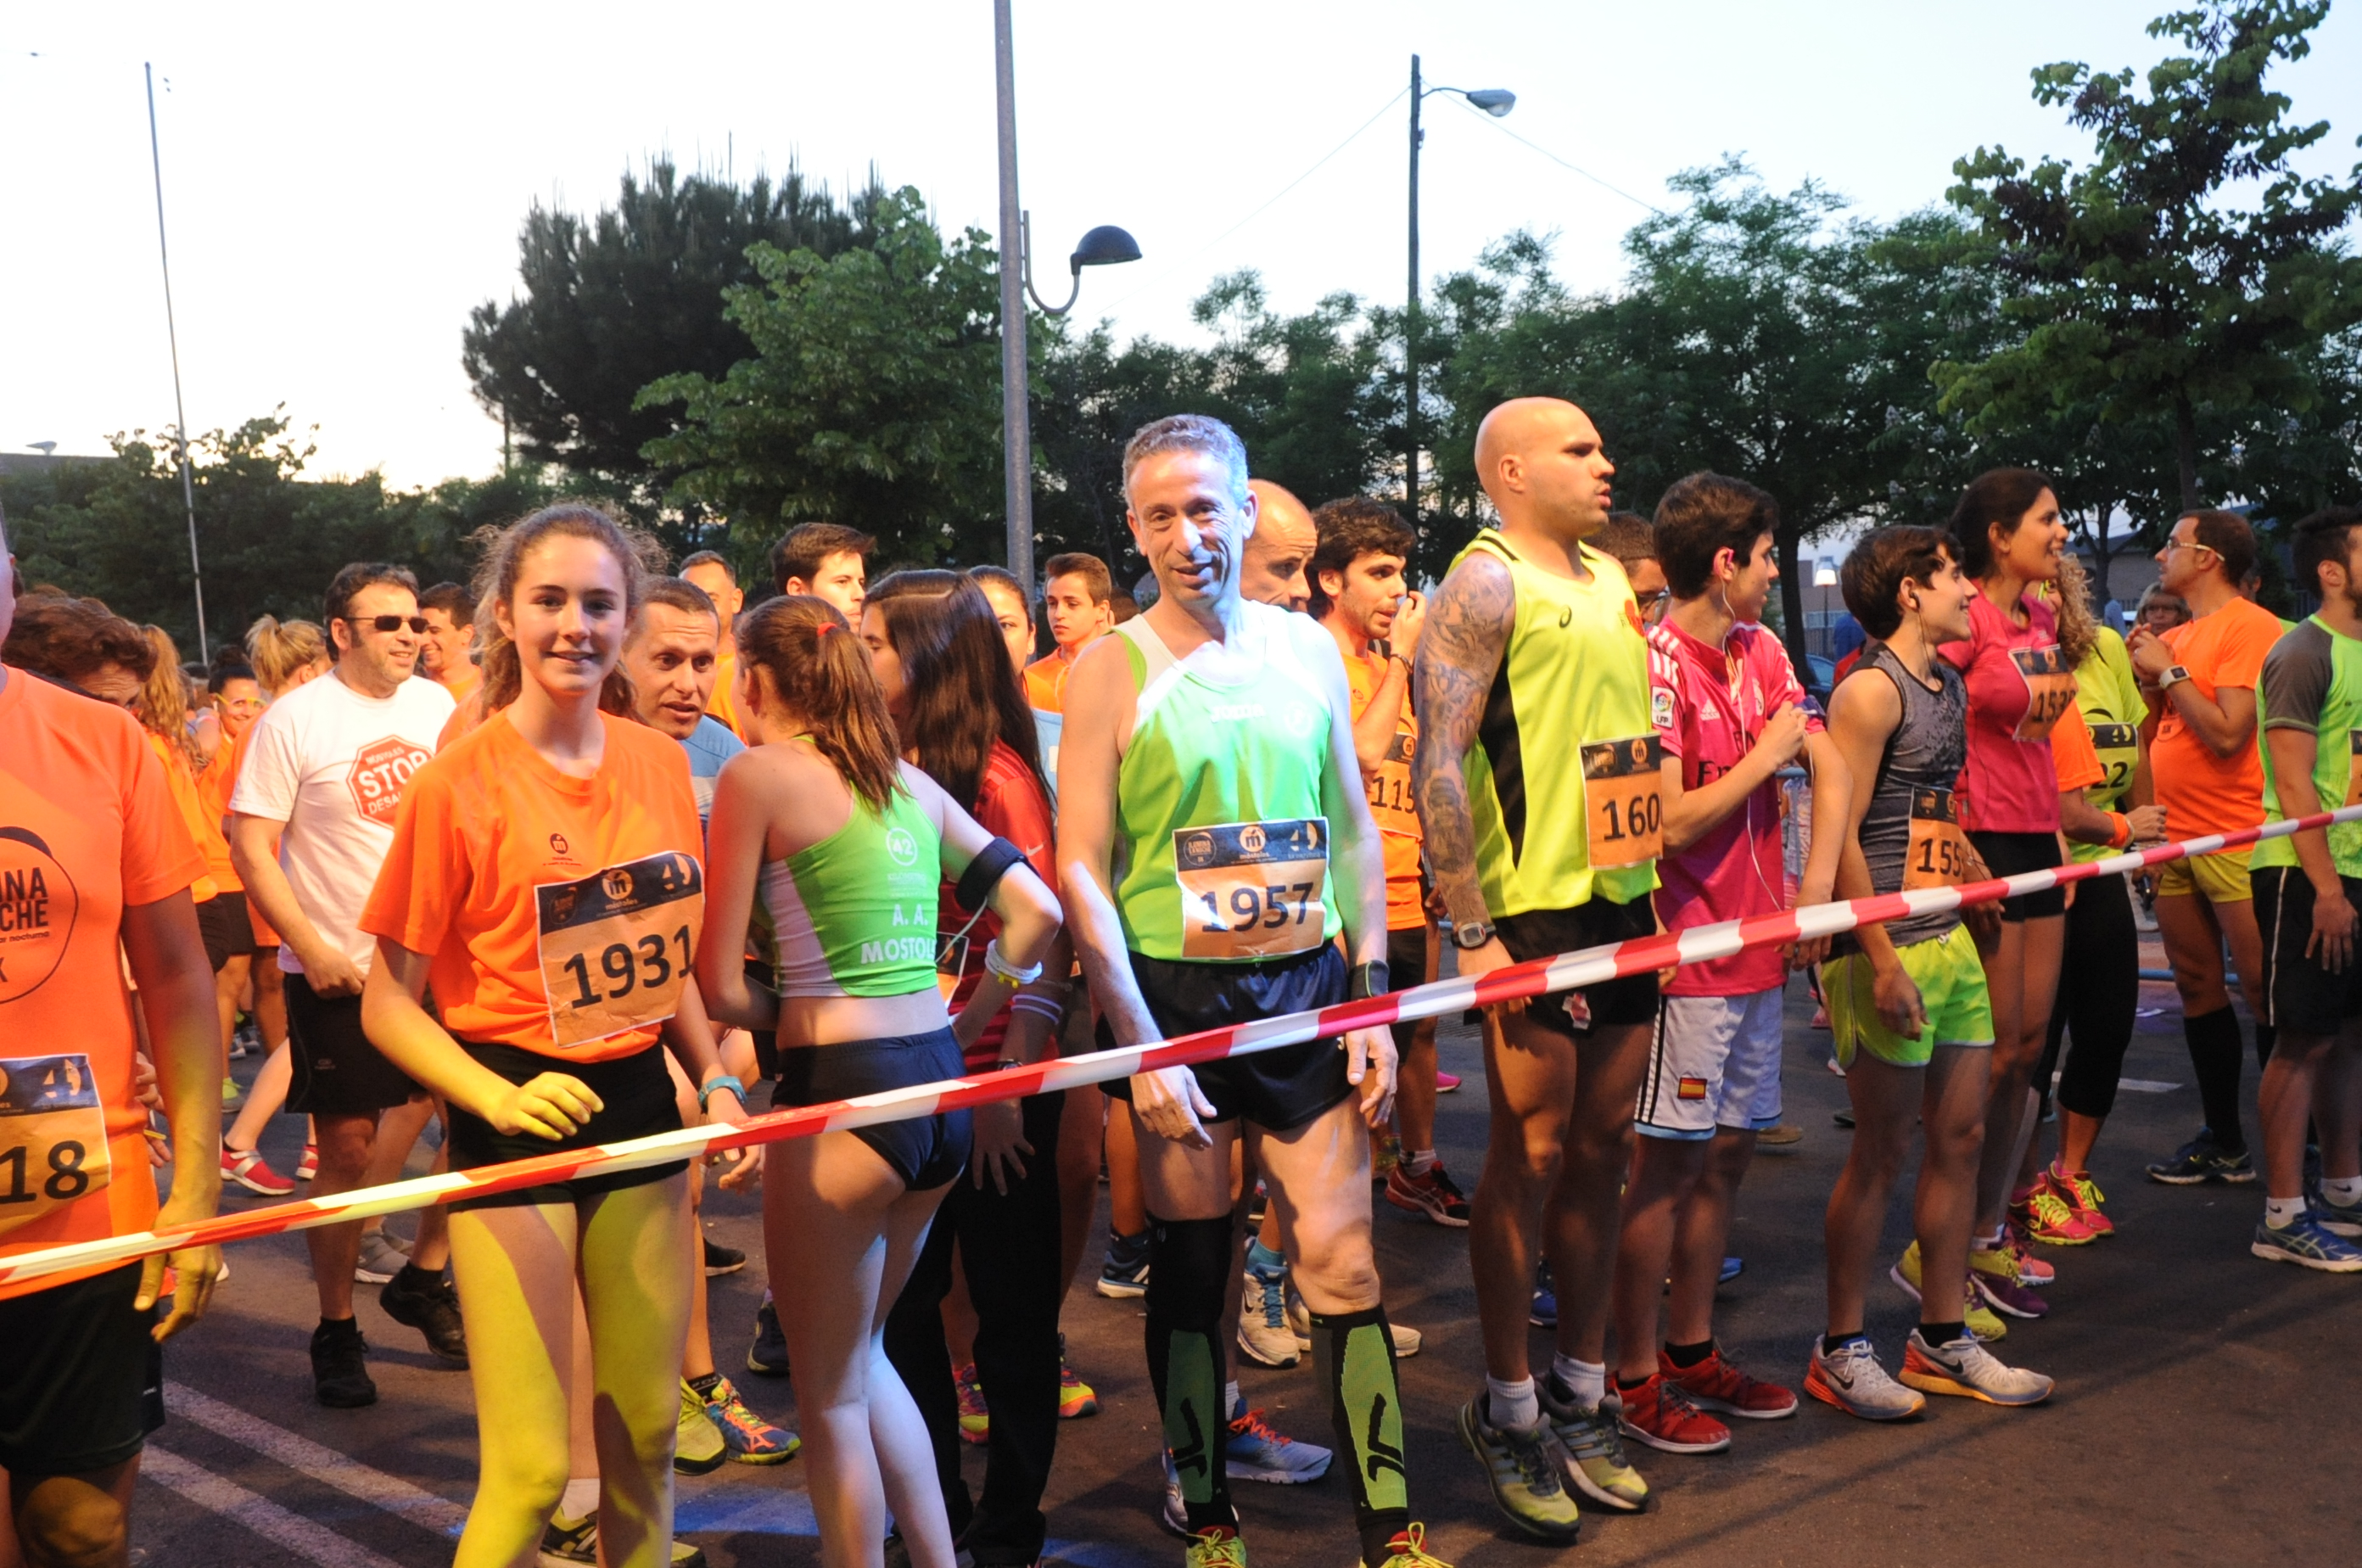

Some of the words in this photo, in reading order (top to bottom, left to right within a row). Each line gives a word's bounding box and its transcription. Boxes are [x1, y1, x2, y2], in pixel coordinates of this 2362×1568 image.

[358, 750, 428, 798] STOP
[367, 792, 401, 815] DESA
[893, 837, 914, 855] 42
[1200, 882, 1314, 932] 1957
[563, 923, 694, 1010] 1931
